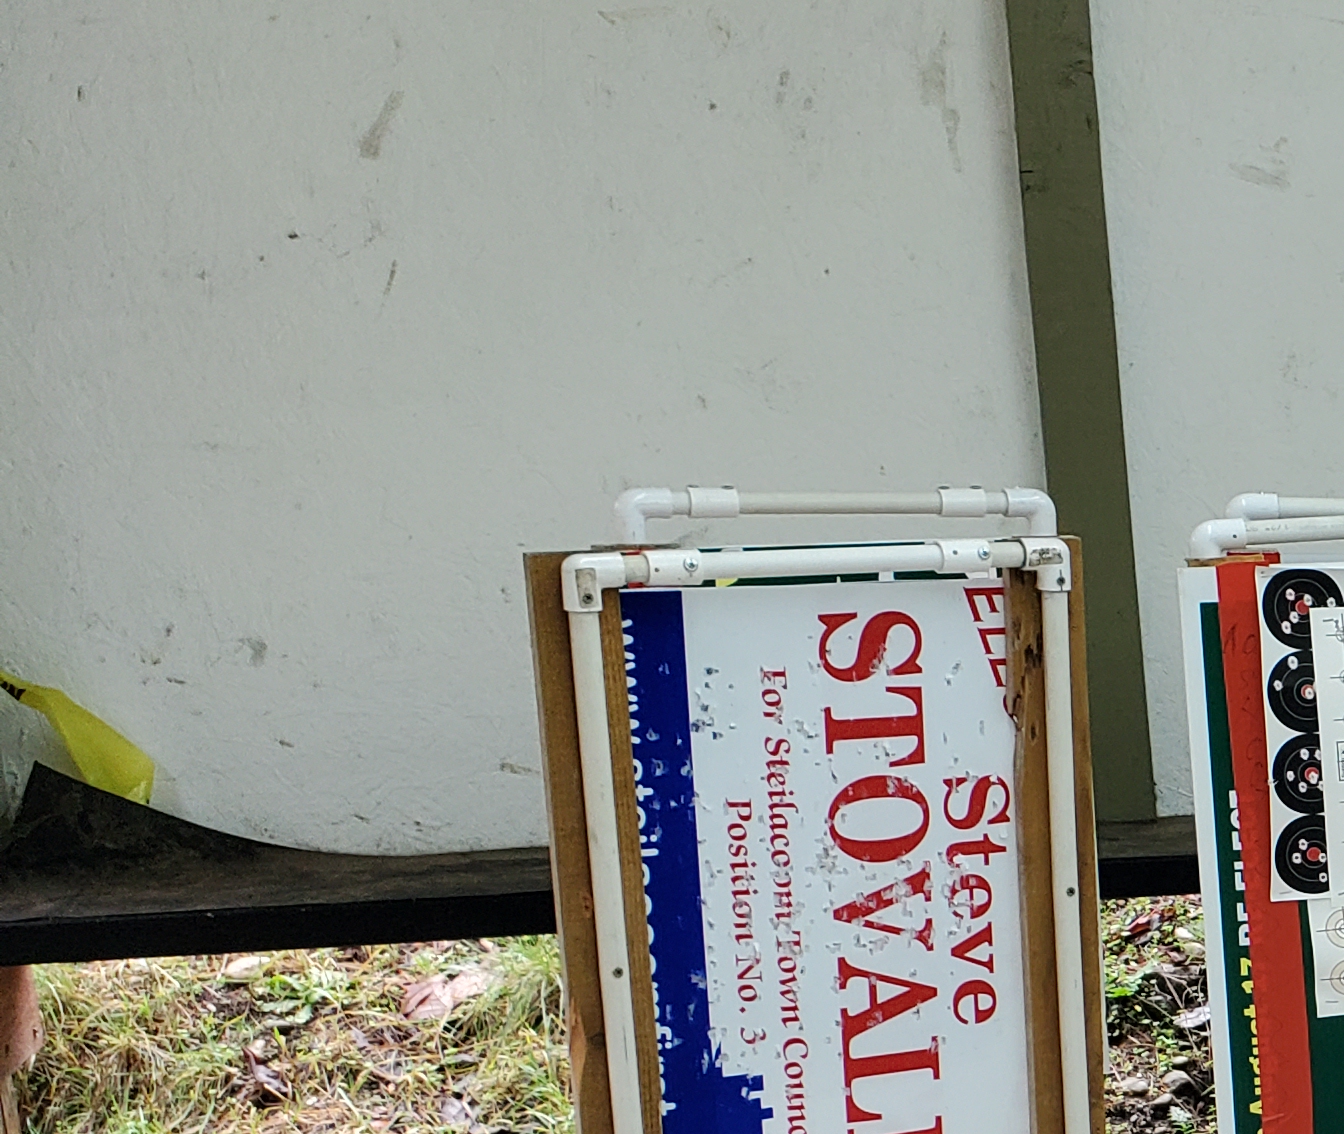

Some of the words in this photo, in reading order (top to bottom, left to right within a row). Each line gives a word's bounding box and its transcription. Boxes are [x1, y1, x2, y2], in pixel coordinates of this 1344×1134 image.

[759, 665, 788, 725] For
[725, 797, 758, 945] Position
[764, 736, 799, 922] Steilacoom
[943, 773, 1010, 1026] Steve
[740, 1027, 767, 1045] 3
[776, 930, 801, 1028] Town
